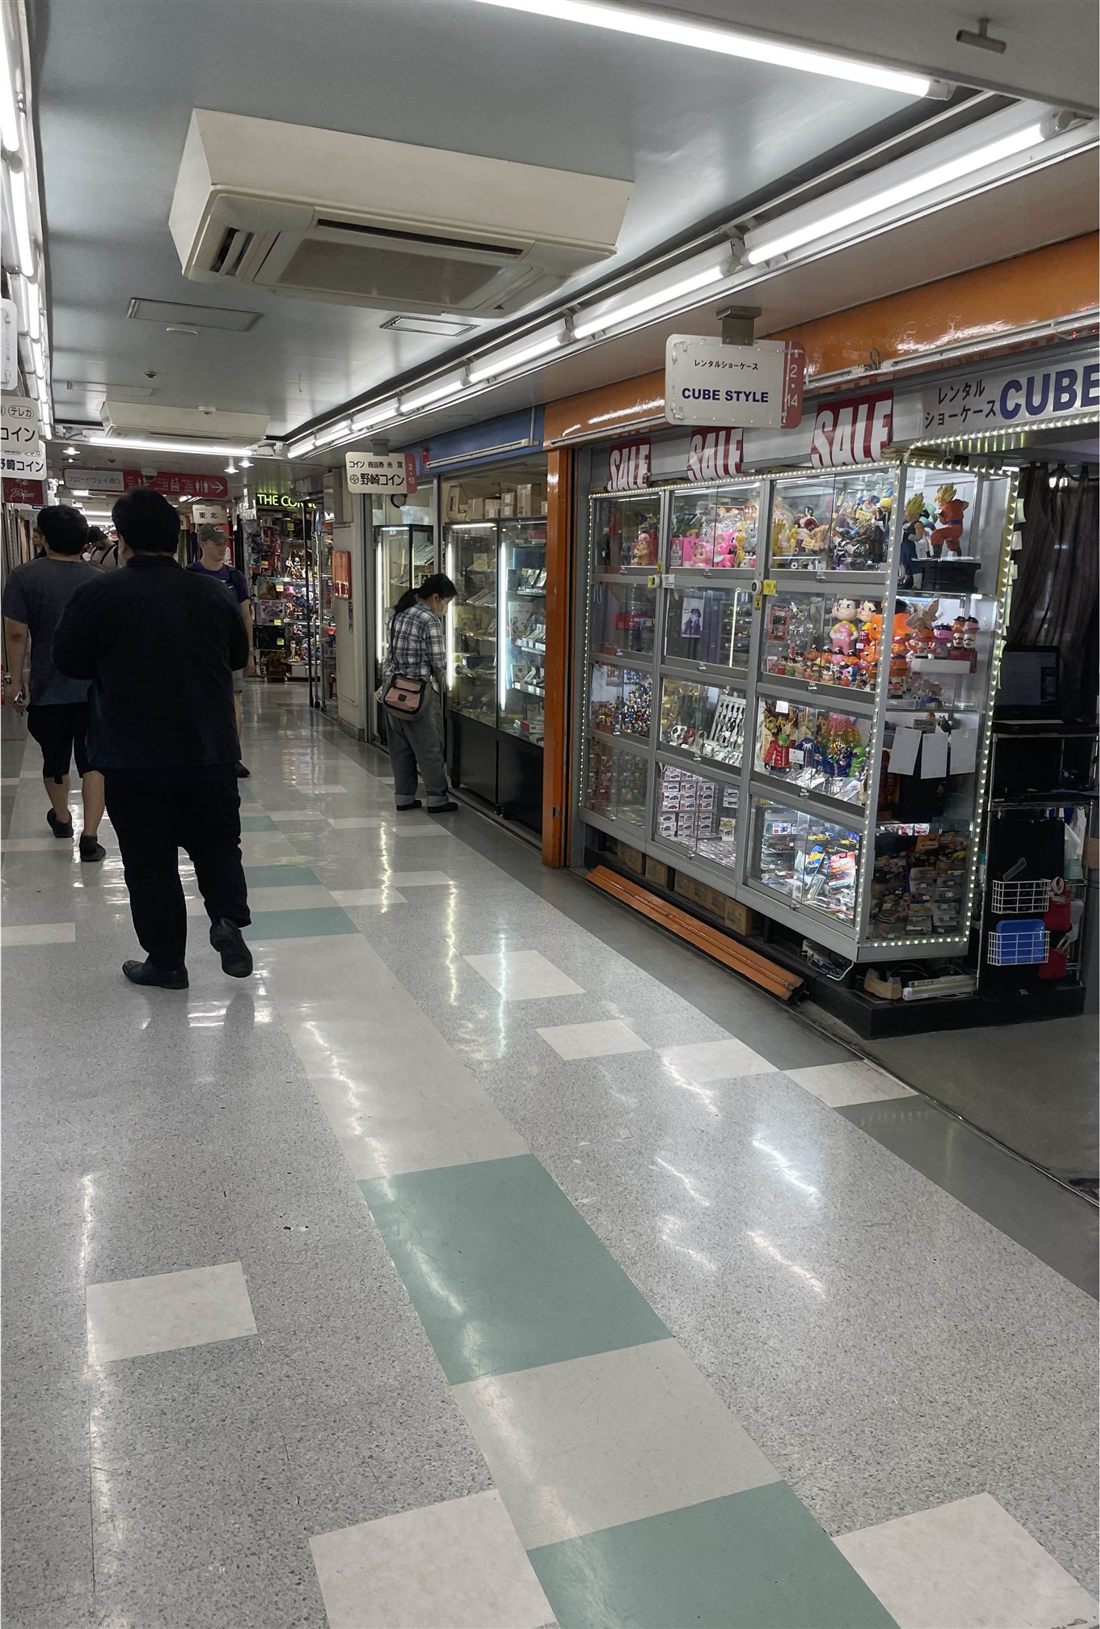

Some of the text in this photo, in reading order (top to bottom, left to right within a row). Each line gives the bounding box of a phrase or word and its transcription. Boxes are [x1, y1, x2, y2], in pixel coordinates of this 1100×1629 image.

[694, 359, 759, 371] レンタルショーケース
[681, 387, 769, 403] CUBE STYLE
[938, 379, 986, 405] レンタル
[1000, 363, 1099, 420] CUBE
[11, 406, 32, 418] テレカ
[924, 400, 997, 430] ショーケース
[811, 400, 892, 469] SALE
[349, 460, 365, 469] コイン
[688, 428, 743, 481] SALE
[607, 444, 651, 492] SALE
[360, 472, 405, 486] 野崎コイン
[257, 493, 279, 506] THE
